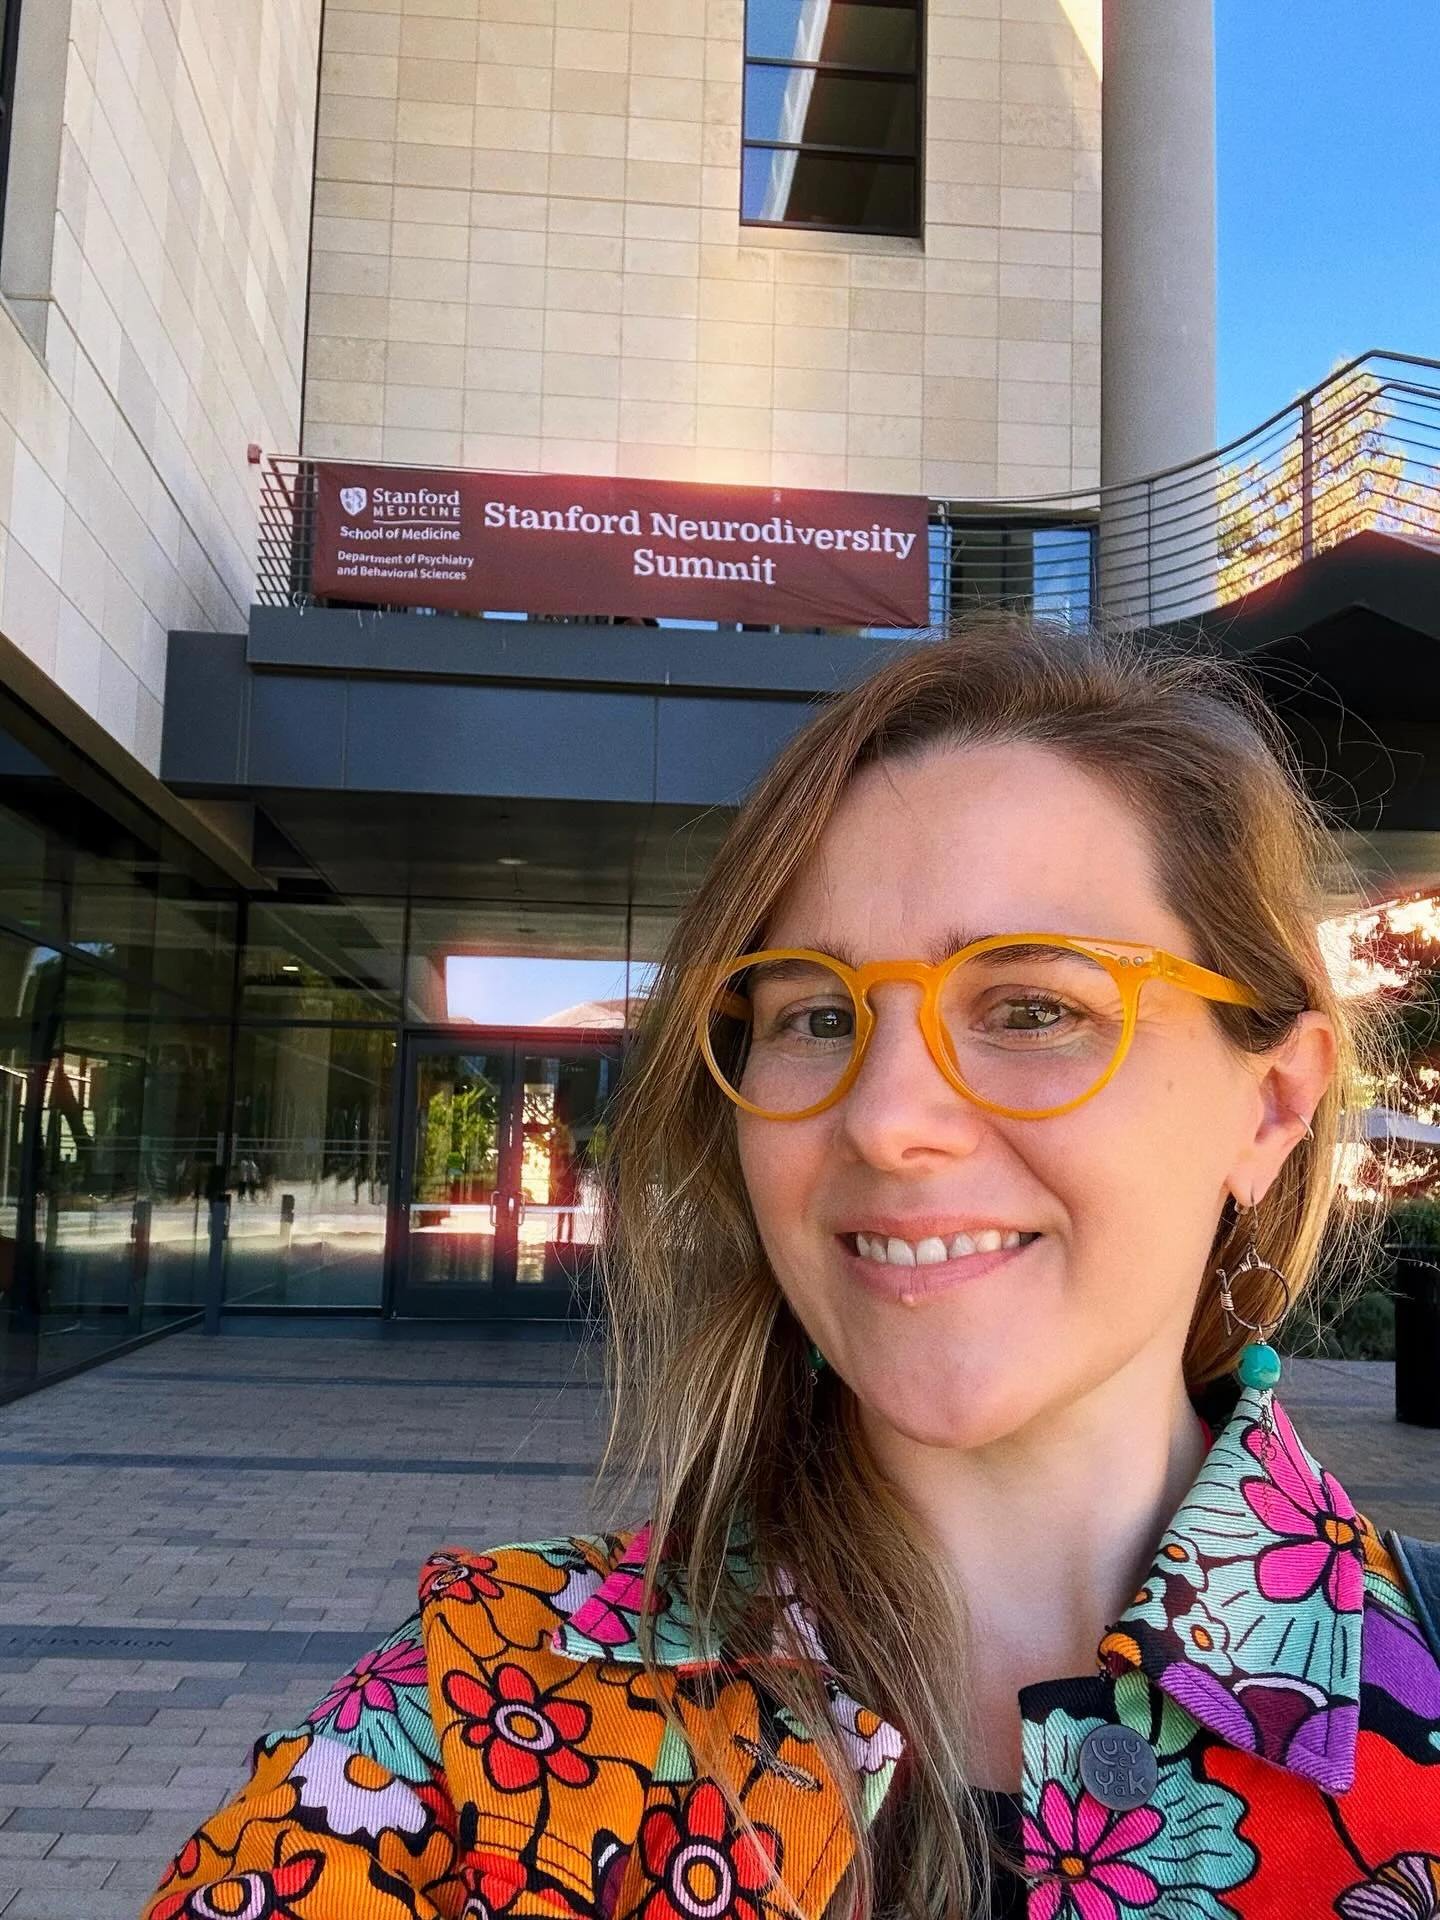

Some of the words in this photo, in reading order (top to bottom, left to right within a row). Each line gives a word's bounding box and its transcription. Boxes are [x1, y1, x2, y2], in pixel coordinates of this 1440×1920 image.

[373, 488, 459, 505] Stanford
[373, 505, 460, 517] MEDICINE
[340, 526, 383, 540] School
[385, 528, 399, 540] of
[402, 528, 460, 540] Medicine
[484, 502, 642, 536] Stanford
[650, 512, 916, 559] Neurodiversity
[338, 550, 403, 564] Department
[405, 554, 416, 564] of
[418, 553, 474, 568] Psychiatry
[633, 548, 776, 584] Summit
[337, 566, 358, 576] and
[360, 566, 418, 579] Behavioral
[420, 568, 467, 580] Sciences
